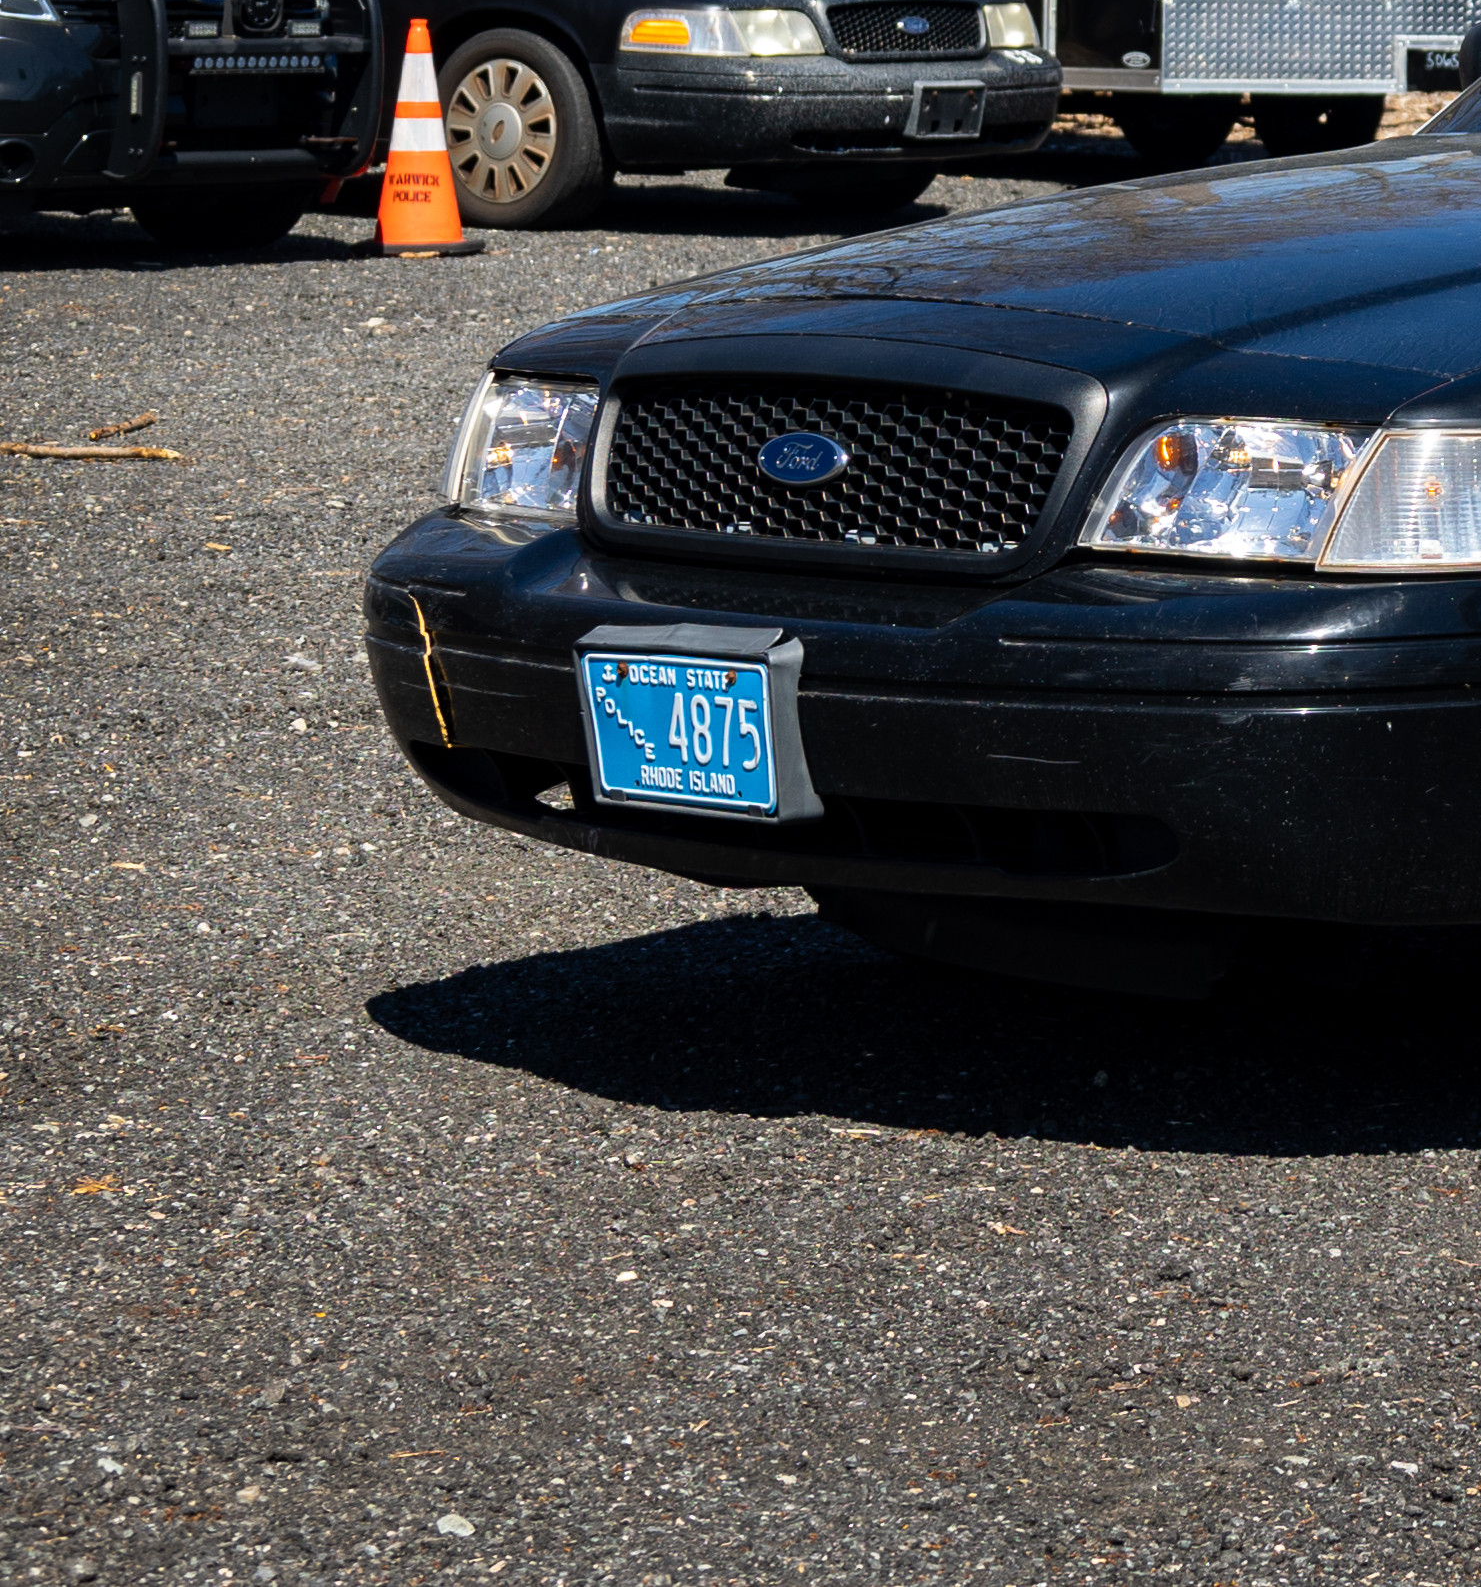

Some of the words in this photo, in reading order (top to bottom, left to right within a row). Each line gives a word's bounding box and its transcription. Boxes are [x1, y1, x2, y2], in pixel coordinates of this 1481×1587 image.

[388, 173, 440, 186] WARWICK
[393, 191, 431, 203] POLICE
[776, 441, 824, 471] Ford
[629, 664, 677, 687] OCEAN
[595, 686, 656, 760] POLICE
[668, 692, 762, 771] 4875
[640, 764, 685, 790] RHODE
[688, 772, 736, 797] ISLAND
